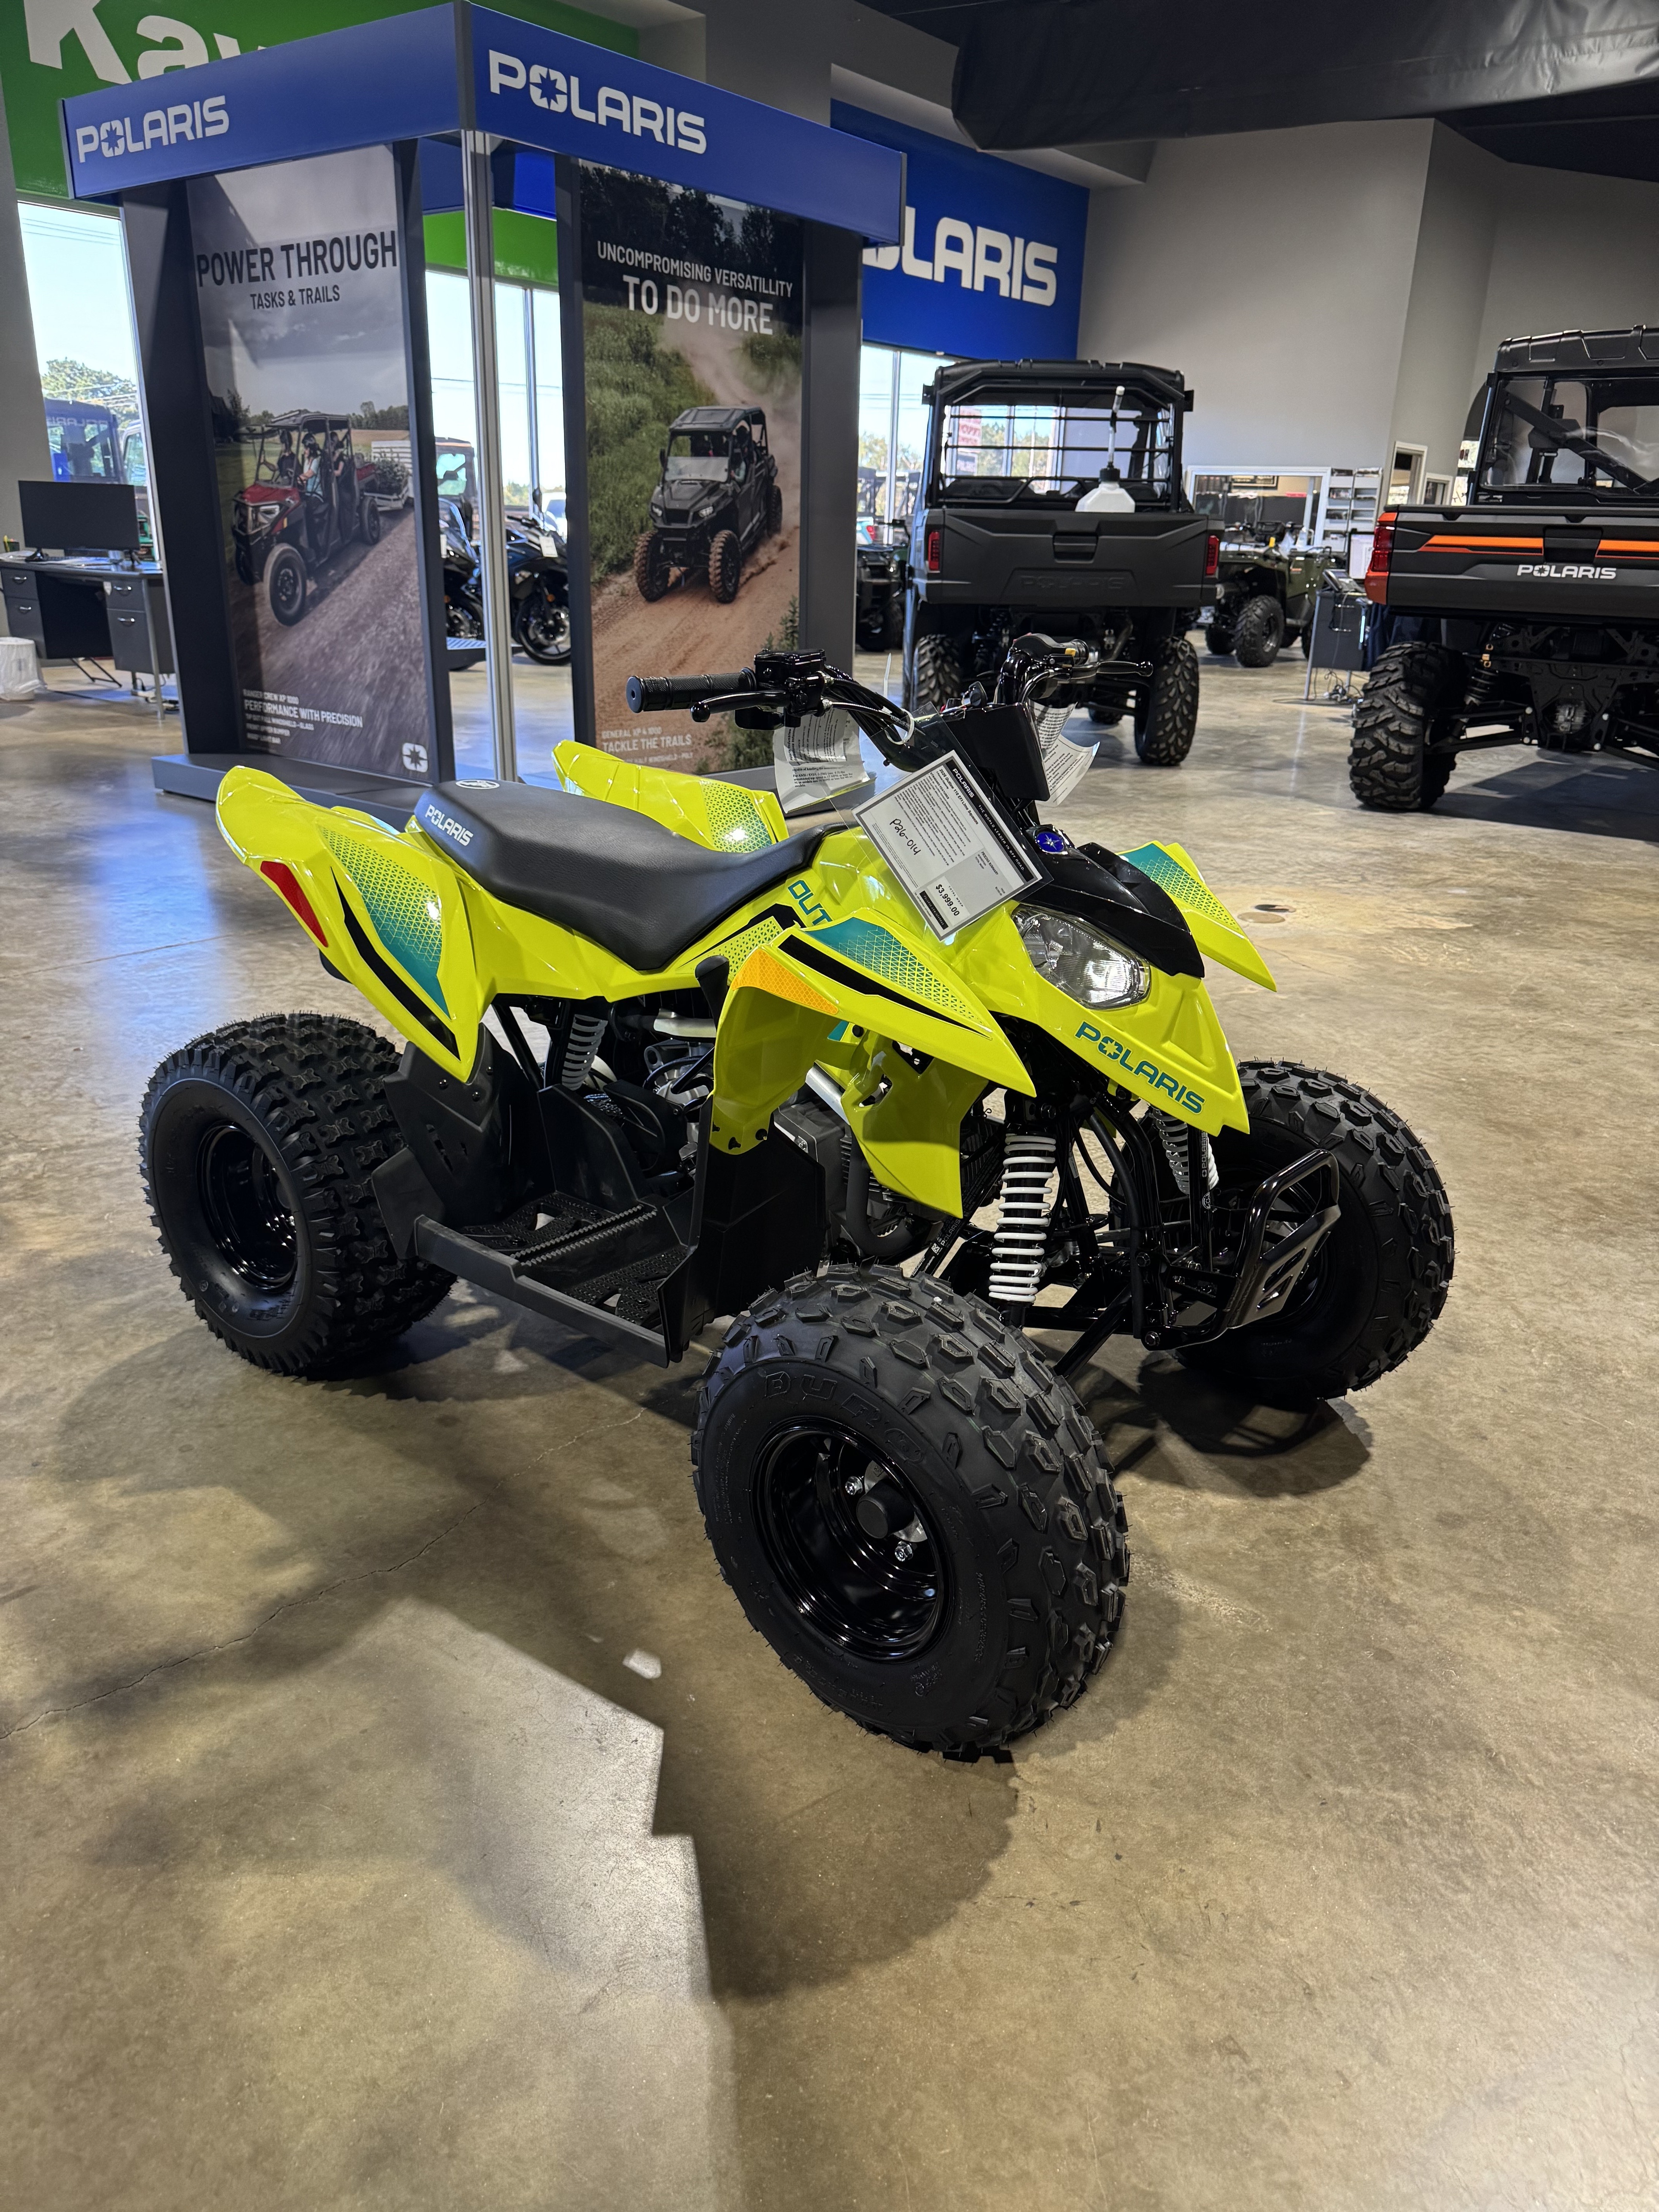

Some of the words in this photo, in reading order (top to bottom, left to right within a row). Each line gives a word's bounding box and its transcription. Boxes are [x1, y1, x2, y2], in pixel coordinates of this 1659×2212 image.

[24, 0, 267, 85] Ka
[489, 50, 707, 154] POLARIS
[76, 95, 230, 163] POLARIS
[196, 247, 274, 287] POWER
[281, 230, 397, 280] THROUGH
[597, 240, 711, 282] UNCOMPROMISING
[714, 268, 793, 297] VERSATILLITY
[251, 292, 285, 310] TASKS
[288, 289, 296, 306] &
[299, 285, 340, 305] TRAILS
[623, 274, 658, 315] TO
[667, 284, 700, 323] DO
[708, 292, 773, 335] MORE
[1517, 564, 1616, 580] POLARIS
[244, 699, 299, 718] PERFORMANCE
[299, 707, 320, 721] WITH
[321, 710, 363, 728] PRECISION
[603, 739, 639, 752] TACKLE
[640, 737, 659, 750] THE
[660, 734, 692, 748] TRAILS
[952, 768, 975, 798] POLARIS
[425, 804, 474, 846] POLARIS
[890, 818, 921, 855] P26-014
[983, 813, 995, 828] WORLD
[993, 828, 1006, 844] LEADER
[935, 883, 960, 916] $3,999.00
[1075, 1021, 1205, 1114] POLARIS
[941, 1219, 961, 1246] POLARIS
